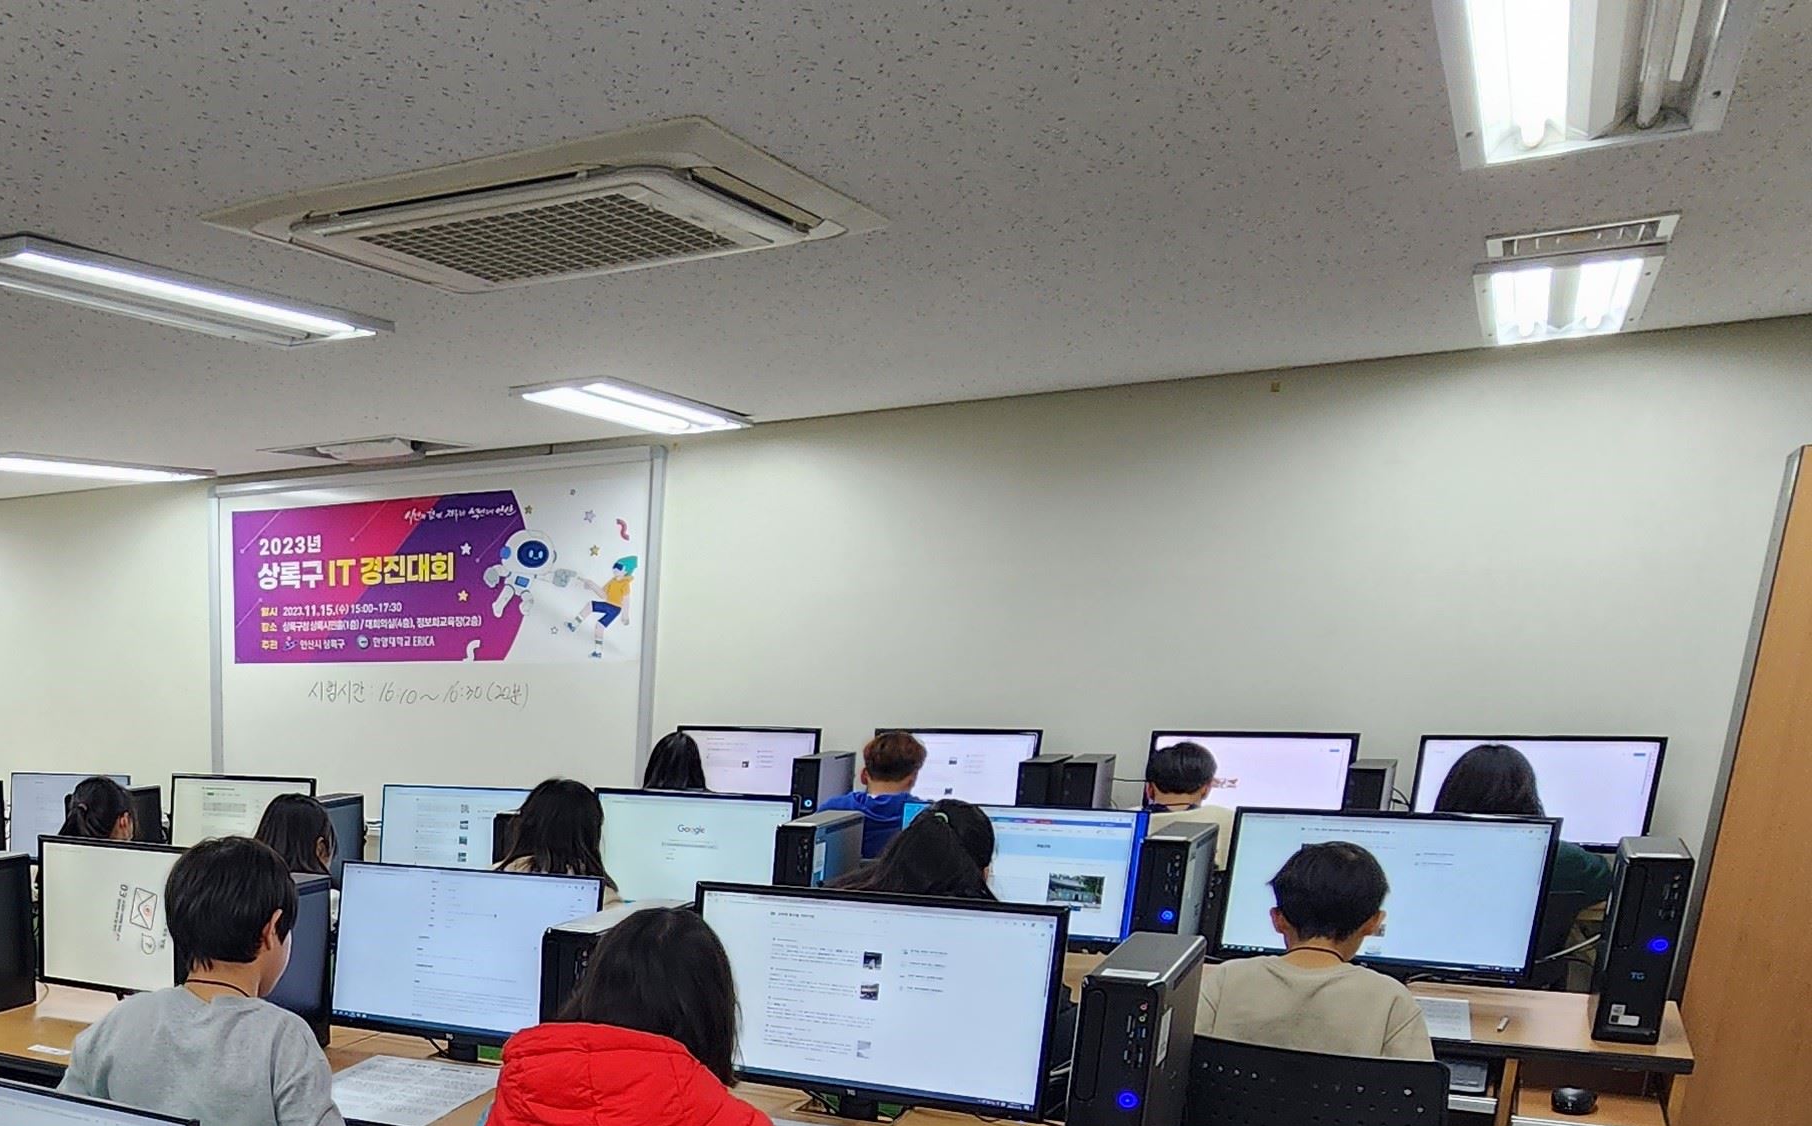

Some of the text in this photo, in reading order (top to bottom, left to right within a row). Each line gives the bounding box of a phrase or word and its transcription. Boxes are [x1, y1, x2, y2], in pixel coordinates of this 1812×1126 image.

[259, 535, 322, 556] 2023년
[258, 552, 455, 590] 상록구 IT 경진대회
[412, 635, 435, 647] ERICA
[677, 824, 706, 835] Google
